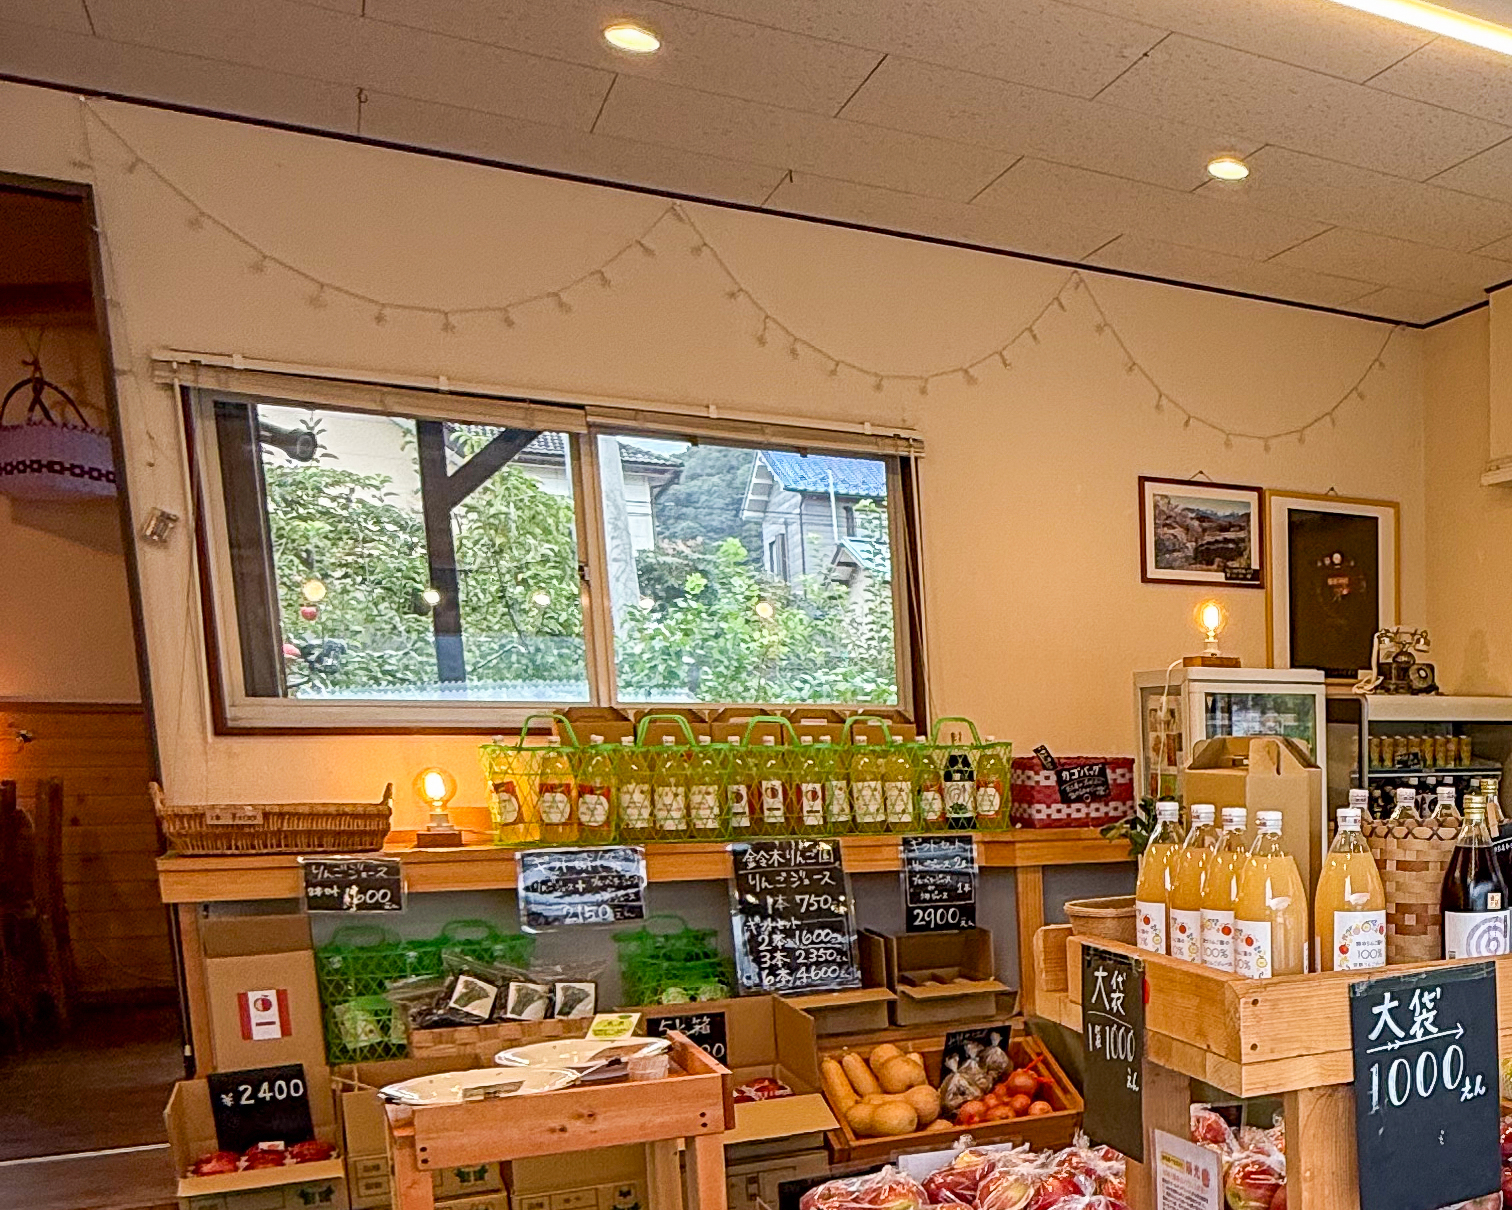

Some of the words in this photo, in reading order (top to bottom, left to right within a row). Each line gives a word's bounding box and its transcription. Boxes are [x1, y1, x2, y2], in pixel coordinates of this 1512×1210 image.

[742, 847, 835, 870] 鈴木りんご園
[311, 863, 388, 880] りんごジュース
[748, 870, 837, 892] りんごジュース
[766, 894, 790, 915] 1本
[759, 951, 790, 968] 3本
[1091, 965, 1127, 1016] 大袋
[1367, 986, 1441, 1041] 大袋
[1105, 1023, 1136, 1063] 1000
[220, 1079, 304, 1107] ¥2400
